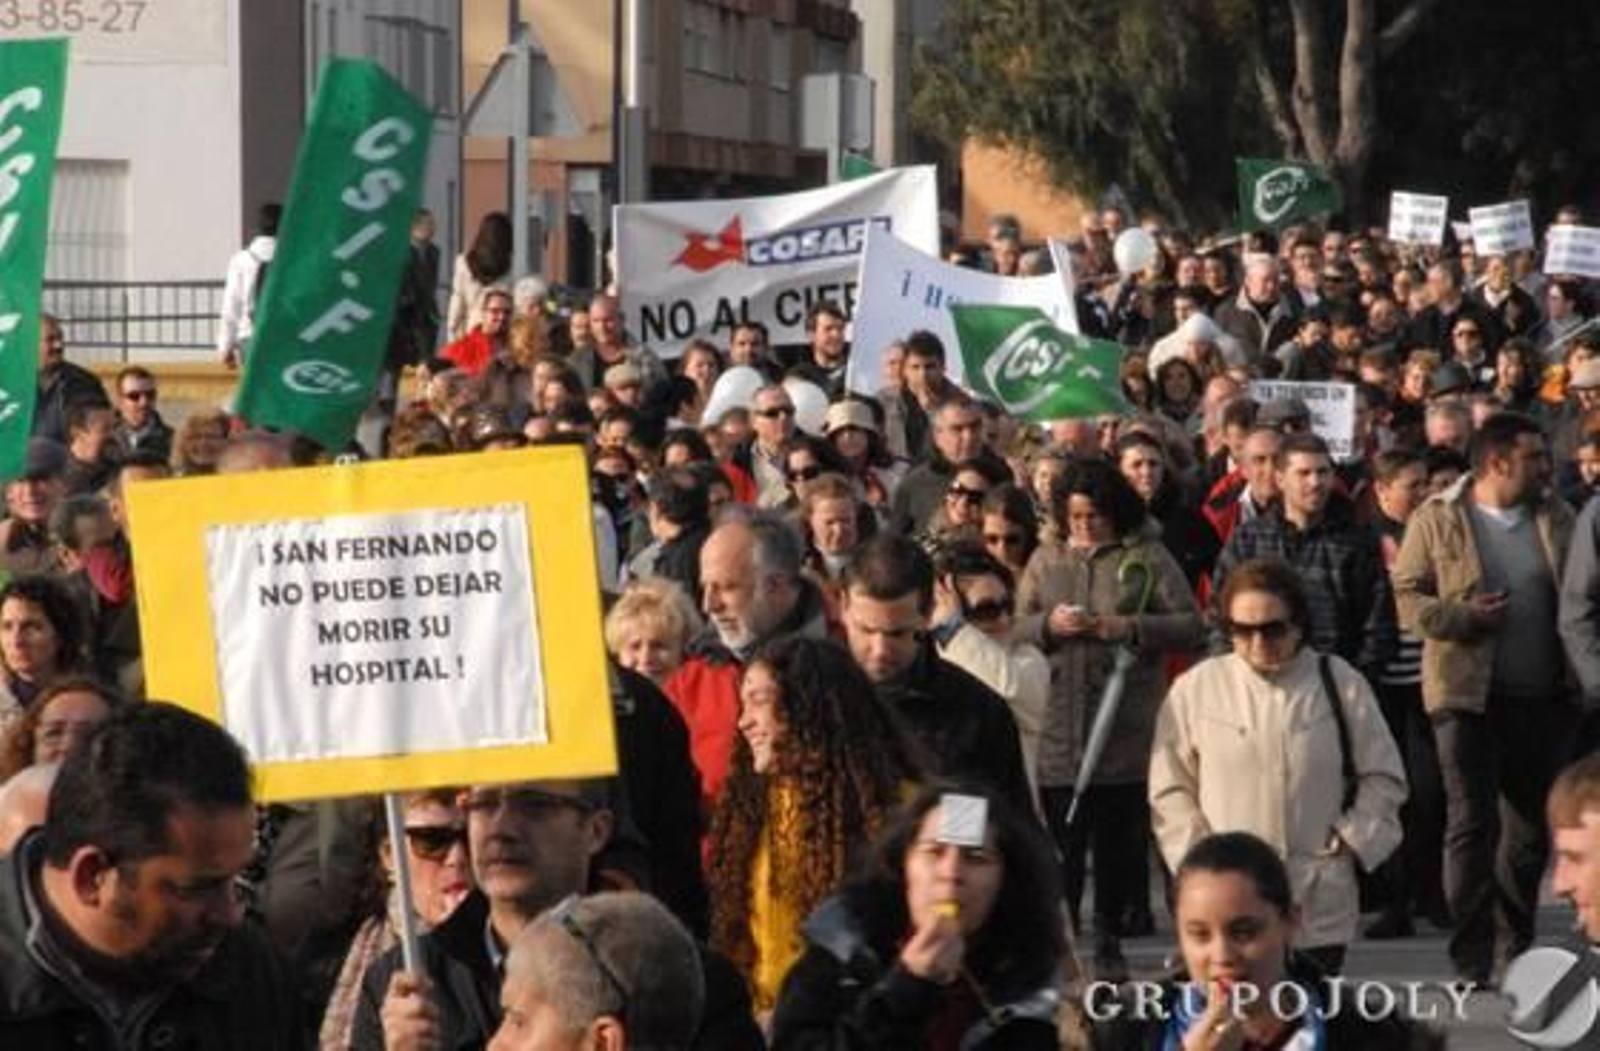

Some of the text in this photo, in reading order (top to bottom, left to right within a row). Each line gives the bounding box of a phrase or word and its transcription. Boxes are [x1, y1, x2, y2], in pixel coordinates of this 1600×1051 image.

[640, 299, 696, 342] NO
[273, 537, 328, 565] SAN
[336, 529, 497, 560] FERNANDO
[259, 571, 503, 607] NO PUEDE DEJAR
[318, 614, 451, 643] MORIR SU
[311, 659, 448, 687] HOSPITAL
